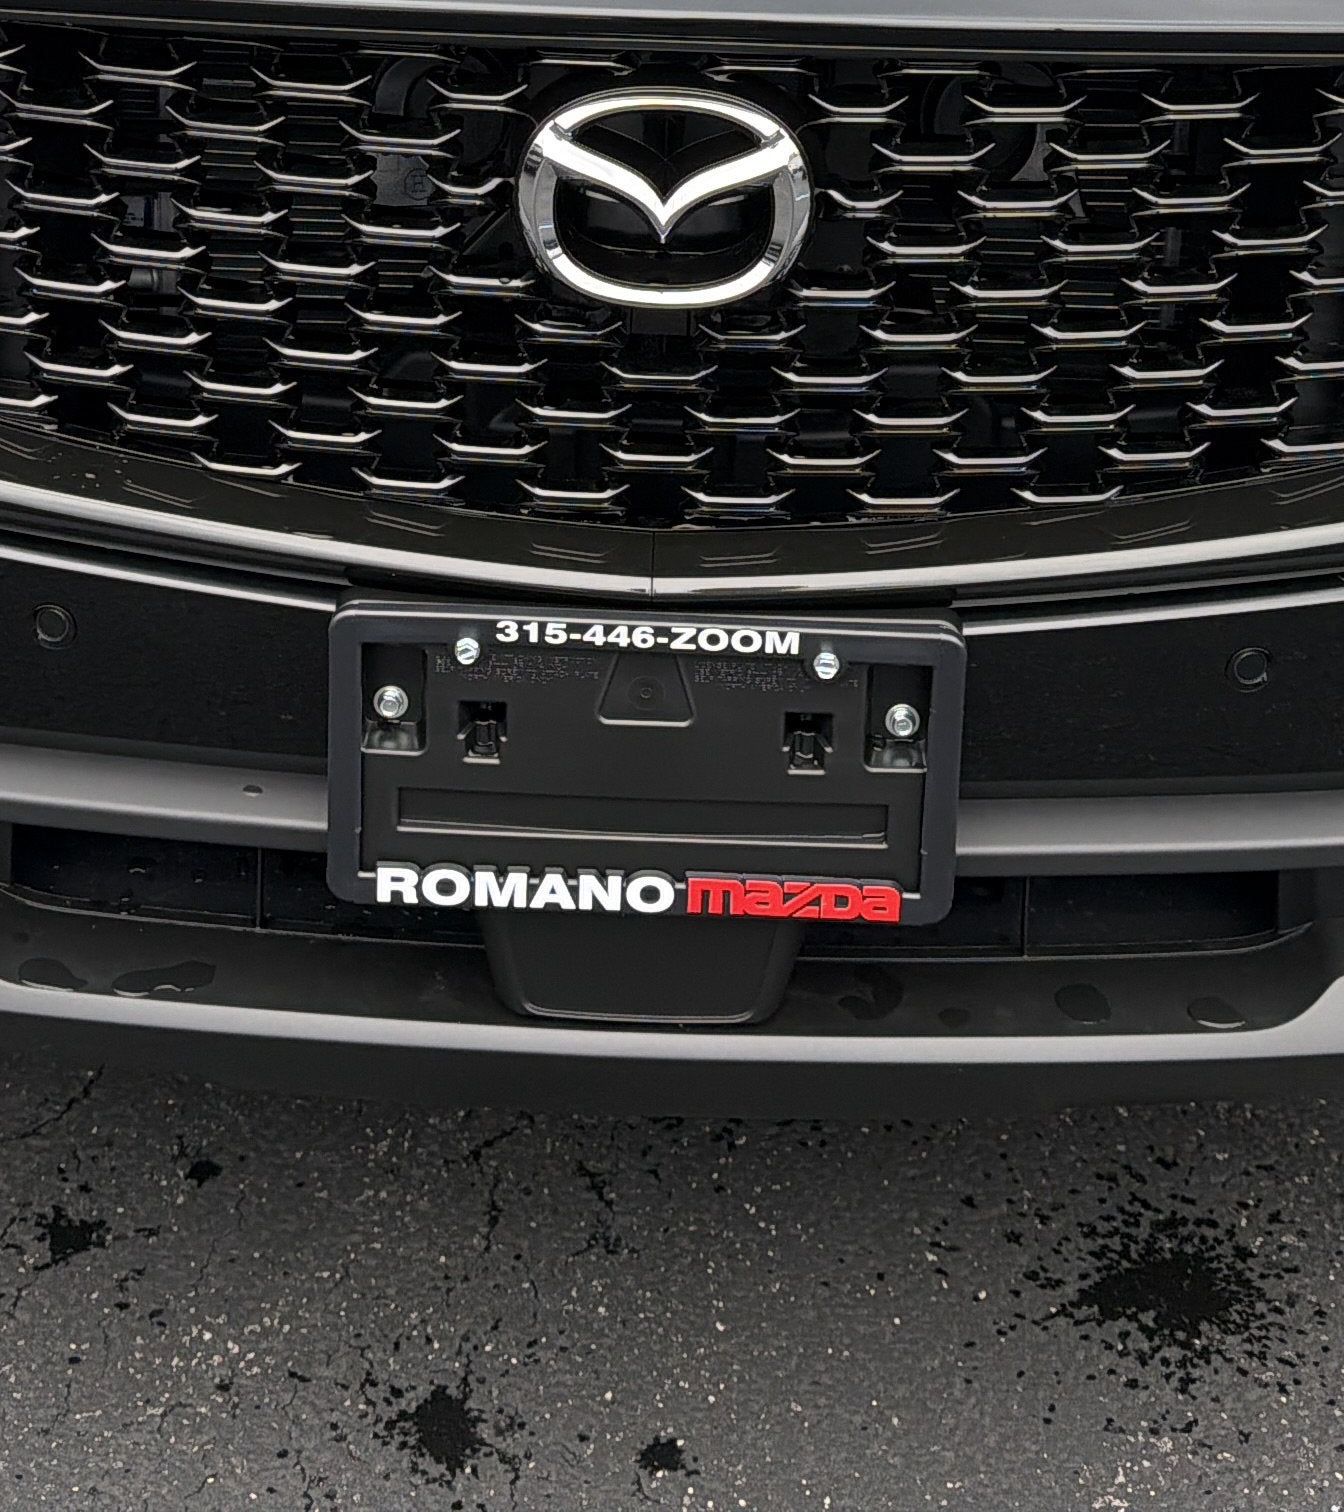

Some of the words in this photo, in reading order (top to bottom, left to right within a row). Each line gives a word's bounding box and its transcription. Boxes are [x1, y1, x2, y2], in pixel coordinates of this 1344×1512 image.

[494, 620, 801, 656] 315-446-ZOOM
[374, 866, 675, 914] ROMANO
[685, 875, 902, 923] mazda
